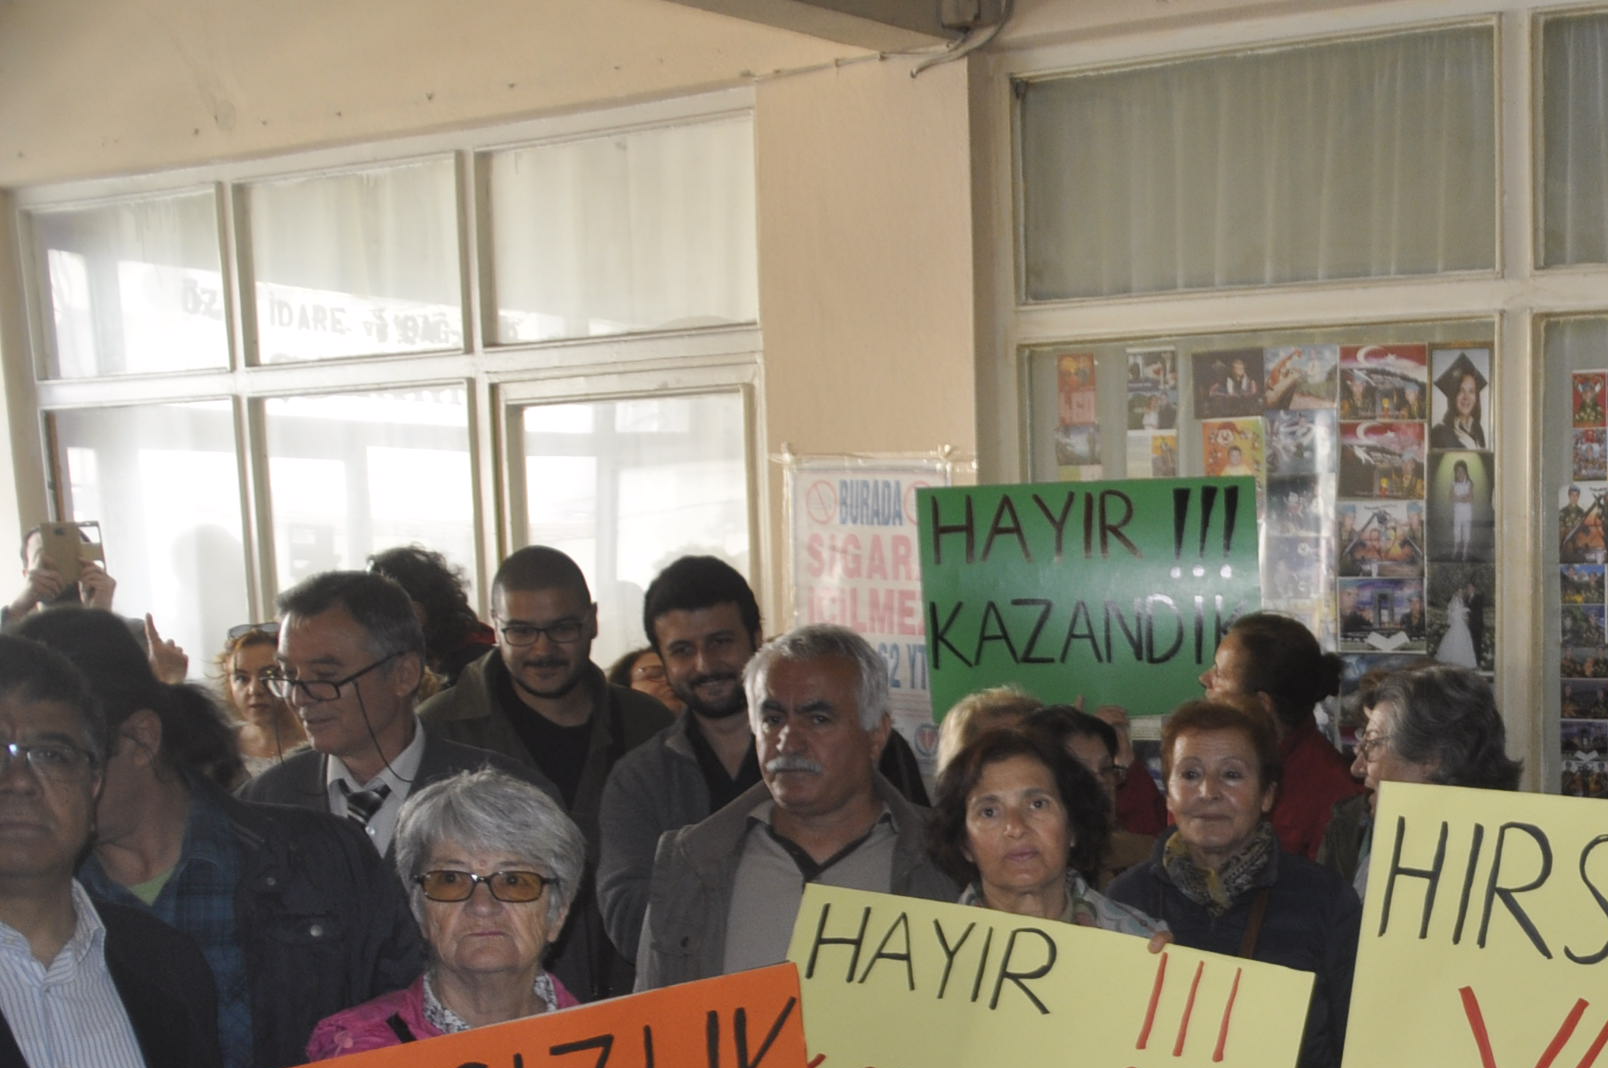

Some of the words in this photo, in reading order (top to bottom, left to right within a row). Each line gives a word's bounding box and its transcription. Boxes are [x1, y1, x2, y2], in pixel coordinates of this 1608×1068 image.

[839, 479, 903, 526] BURADA
[931, 489, 1143, 565] HAYIR
[806, 532, 921, 581] SİGAR
[805, 903, 1058, 1015] HAYIR
